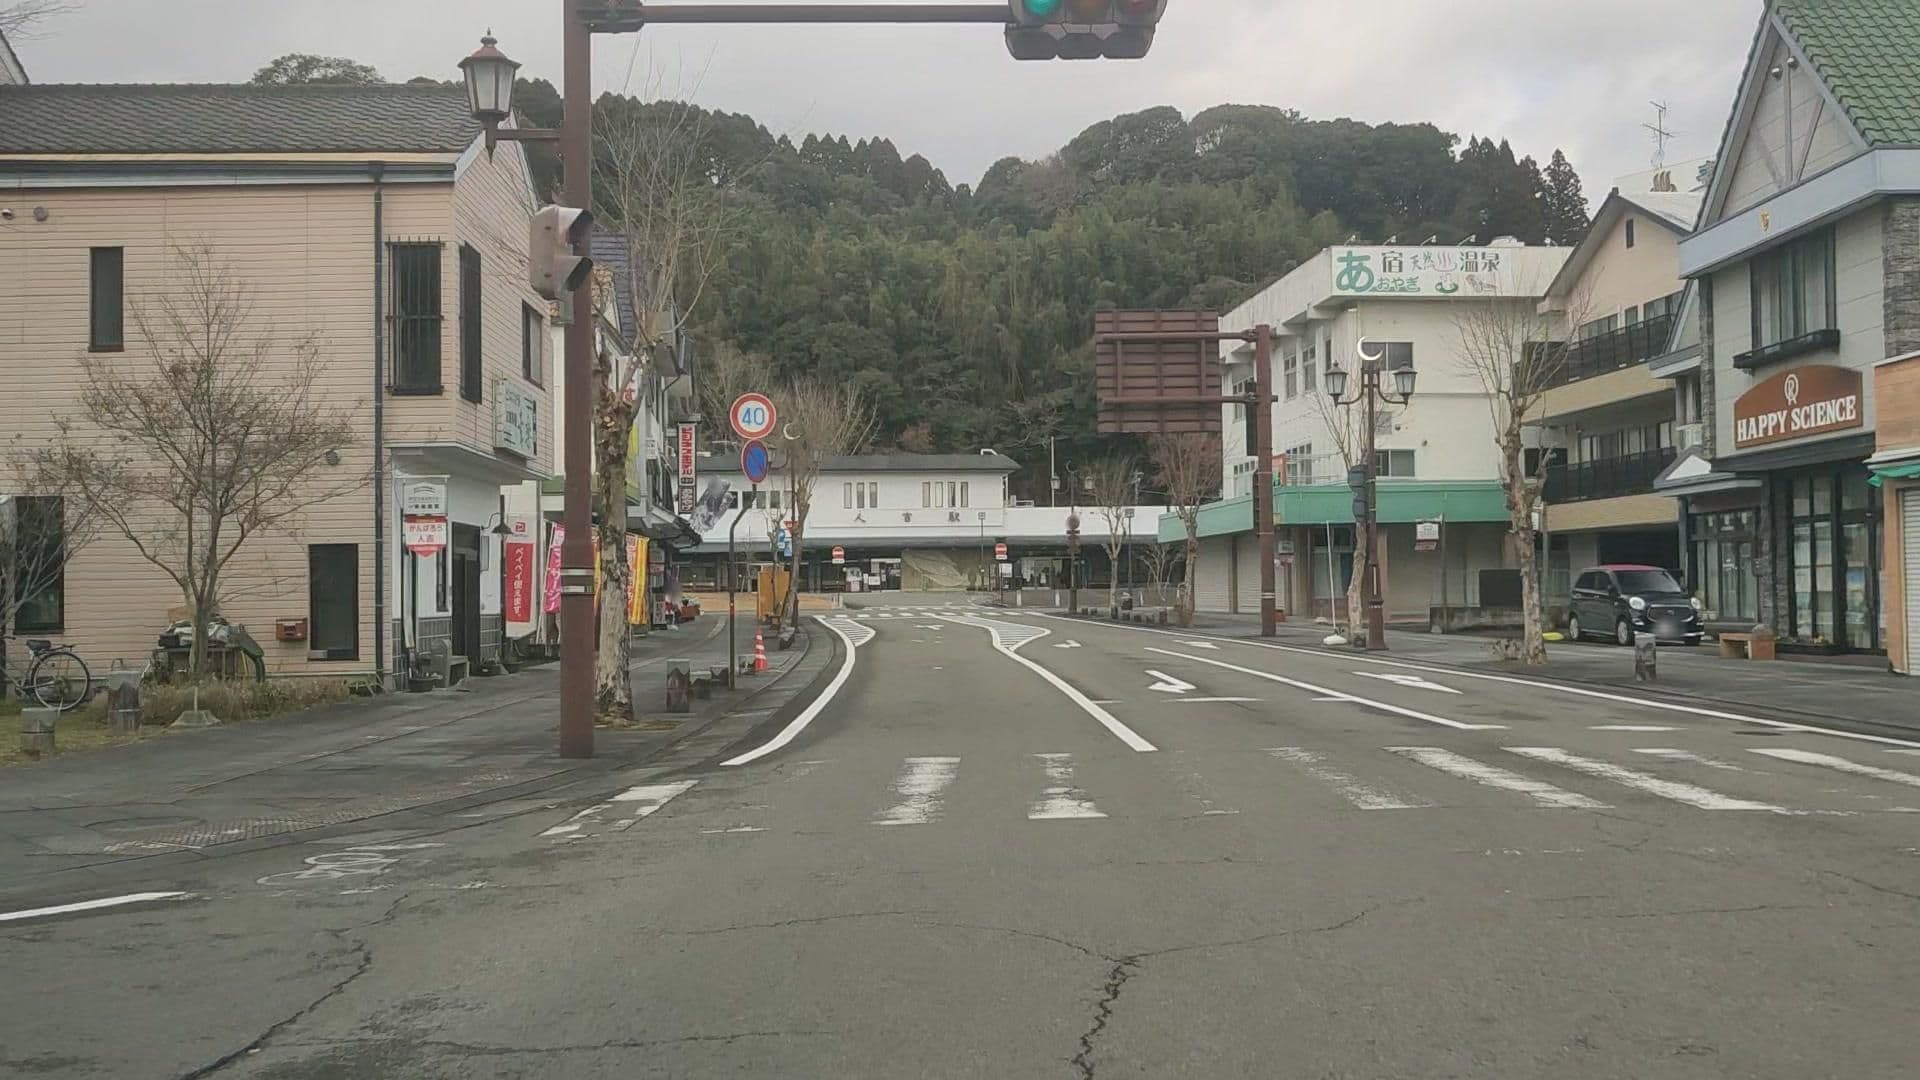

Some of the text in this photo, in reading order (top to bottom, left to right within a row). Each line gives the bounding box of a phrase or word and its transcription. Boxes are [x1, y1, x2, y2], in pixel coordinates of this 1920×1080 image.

[1459, 251, 1500, 273] 温泉
[742, 407, 765, 426] 40
[1737, 395, 1856, 442] HAPPY SCIENCE
